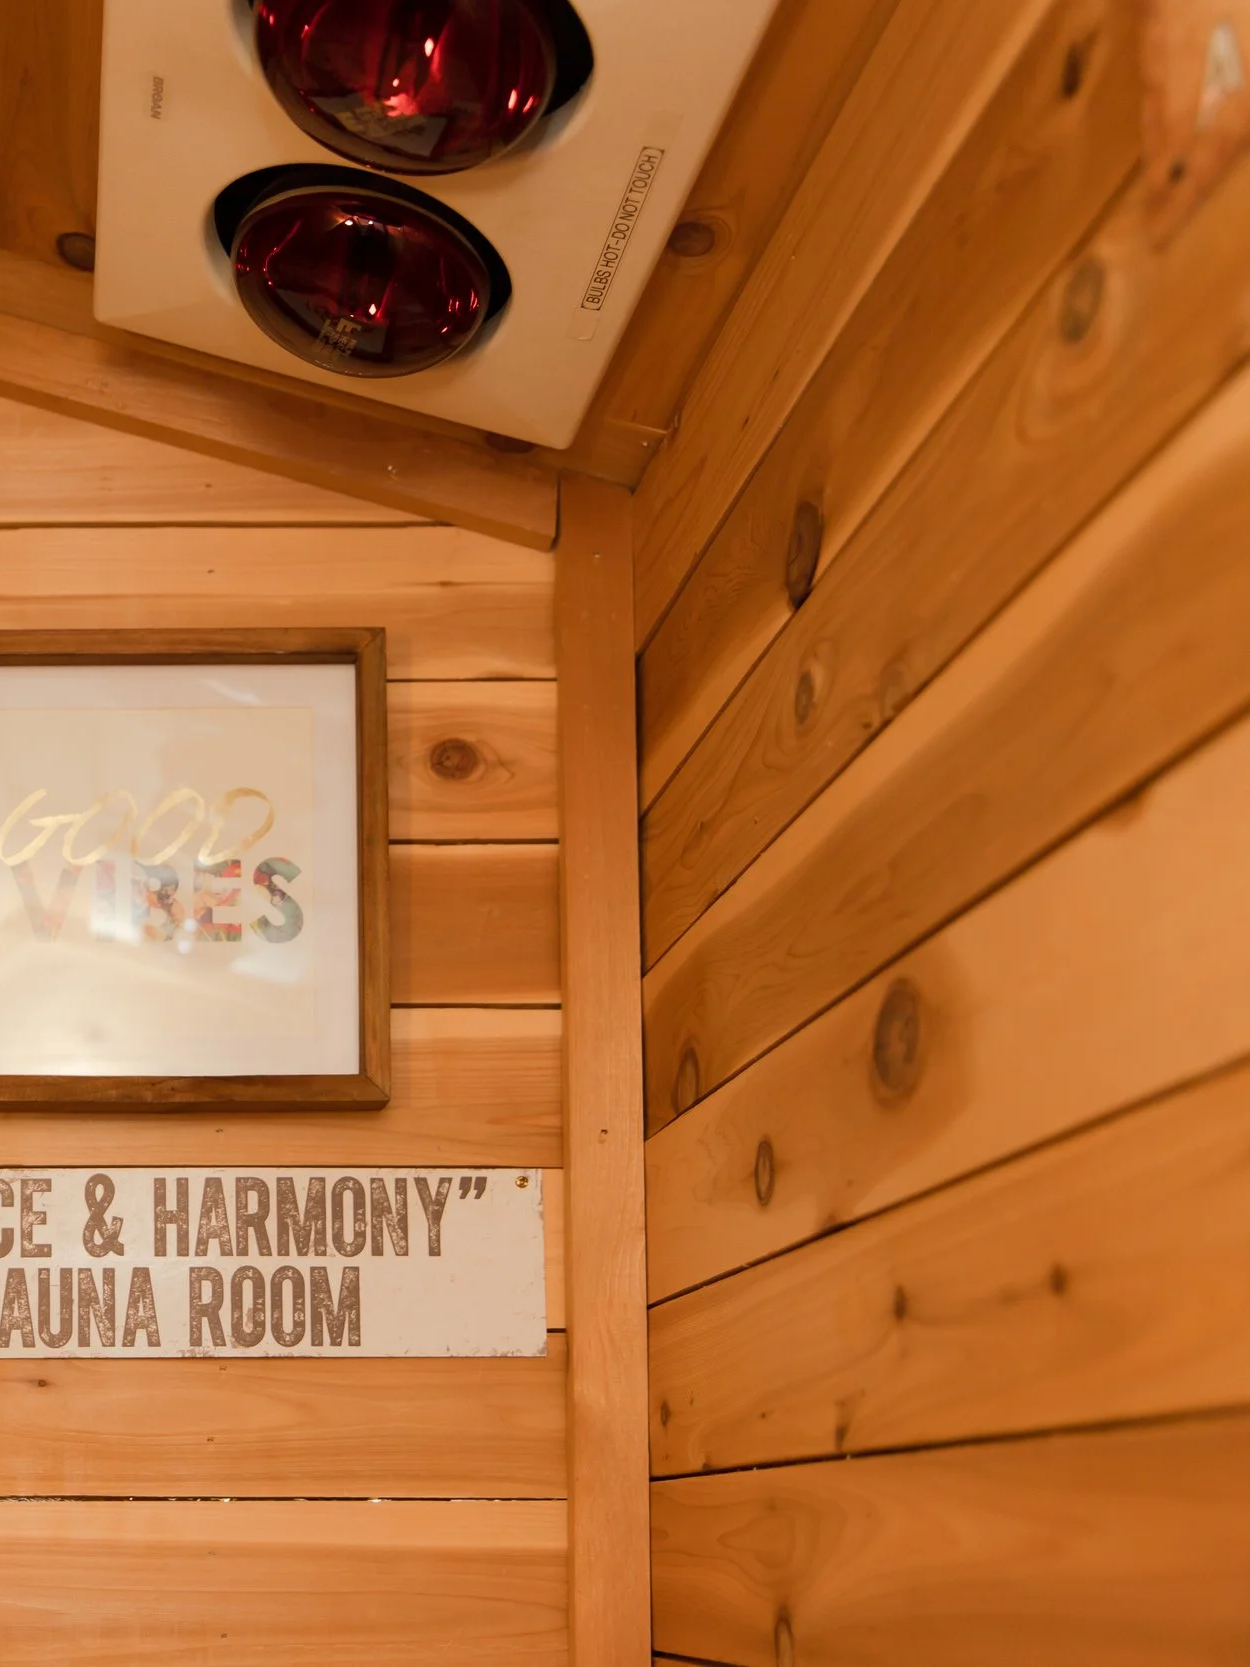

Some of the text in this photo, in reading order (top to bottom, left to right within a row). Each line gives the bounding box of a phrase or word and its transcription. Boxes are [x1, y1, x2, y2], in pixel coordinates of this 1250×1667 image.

[628, 153, 659, 194] TOUCH
[618, 196, 640, 222] NOT
[585, 269, 611, 304] BULBS
[9, 856, 304, 943] VIBES
[82, 1173, 125, 1258] &
[189, 1265, 361, 1348] ROOM
